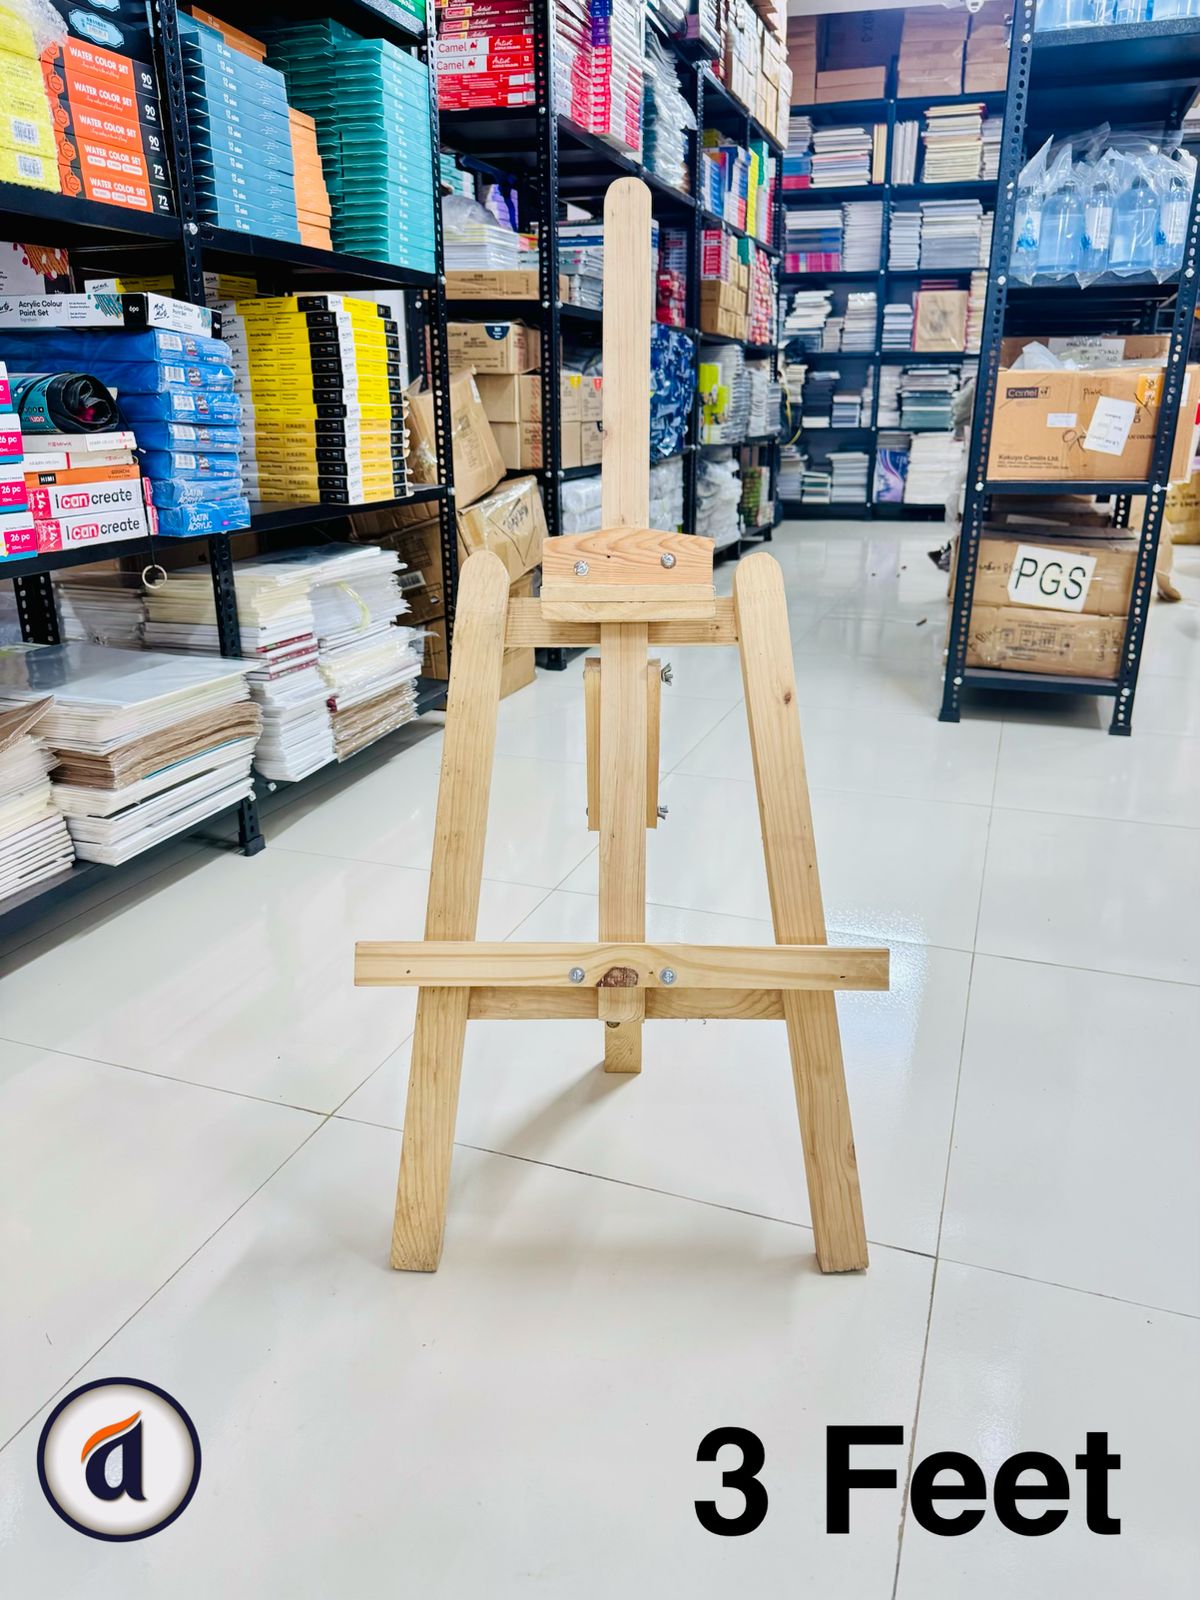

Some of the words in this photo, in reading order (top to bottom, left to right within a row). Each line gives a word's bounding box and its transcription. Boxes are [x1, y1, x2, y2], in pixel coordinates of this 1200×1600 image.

[438, 42, 467, 53] Camel
[69, 47, 93, 61] WATER
[95, 56, 117, 70] COLOR
[119, 62, 129, 74] SET
[436, 59, 465, 71] Camel
[141, 72, 153, 86] 90
[74, 81, 97, 97] WATER
[99, 90, 121, 105] COLOR
[122, 96, 132, 108] SET
[144, 104, 156, 117] 90
[79, 115, 102, 130] WATER
[104, 121, 125, 136] COLOR
[126, 126, 137, 139] SET
[149, 135, 160, 148] 90
[84, 144, 107, 158] WATER
[108, 150, 130, 163] COLOR
[131, 155, 142, 166] SET
[153, 163, 164, 176] 72
[89, 177, 112, 190] WATER
[113, 182, 135, 195] COLOR
[136, 186, 146, 197] SET
[157, 194, 169, 206] 72
[19, 300, 40, 310] Acrylic
[42, 300, 62, 308] Colour
[129, 305, 140, 313] 6pc
[8, 437, 17, 445] pc
[40, 474, 55, 483] HIMI
[1, 485, 10, 493] 26
[12, 486, 21, 495] pc
[62, 494, 89, 508] can
[91, 488, 132, 505] create
[72, 525, 98, 540] can
[100, 518, 140, 535] create
[10, 533, 19, 542] 26
[21, 533, 30, 543] pc
[1015, 557, 1086, 600] PGS
